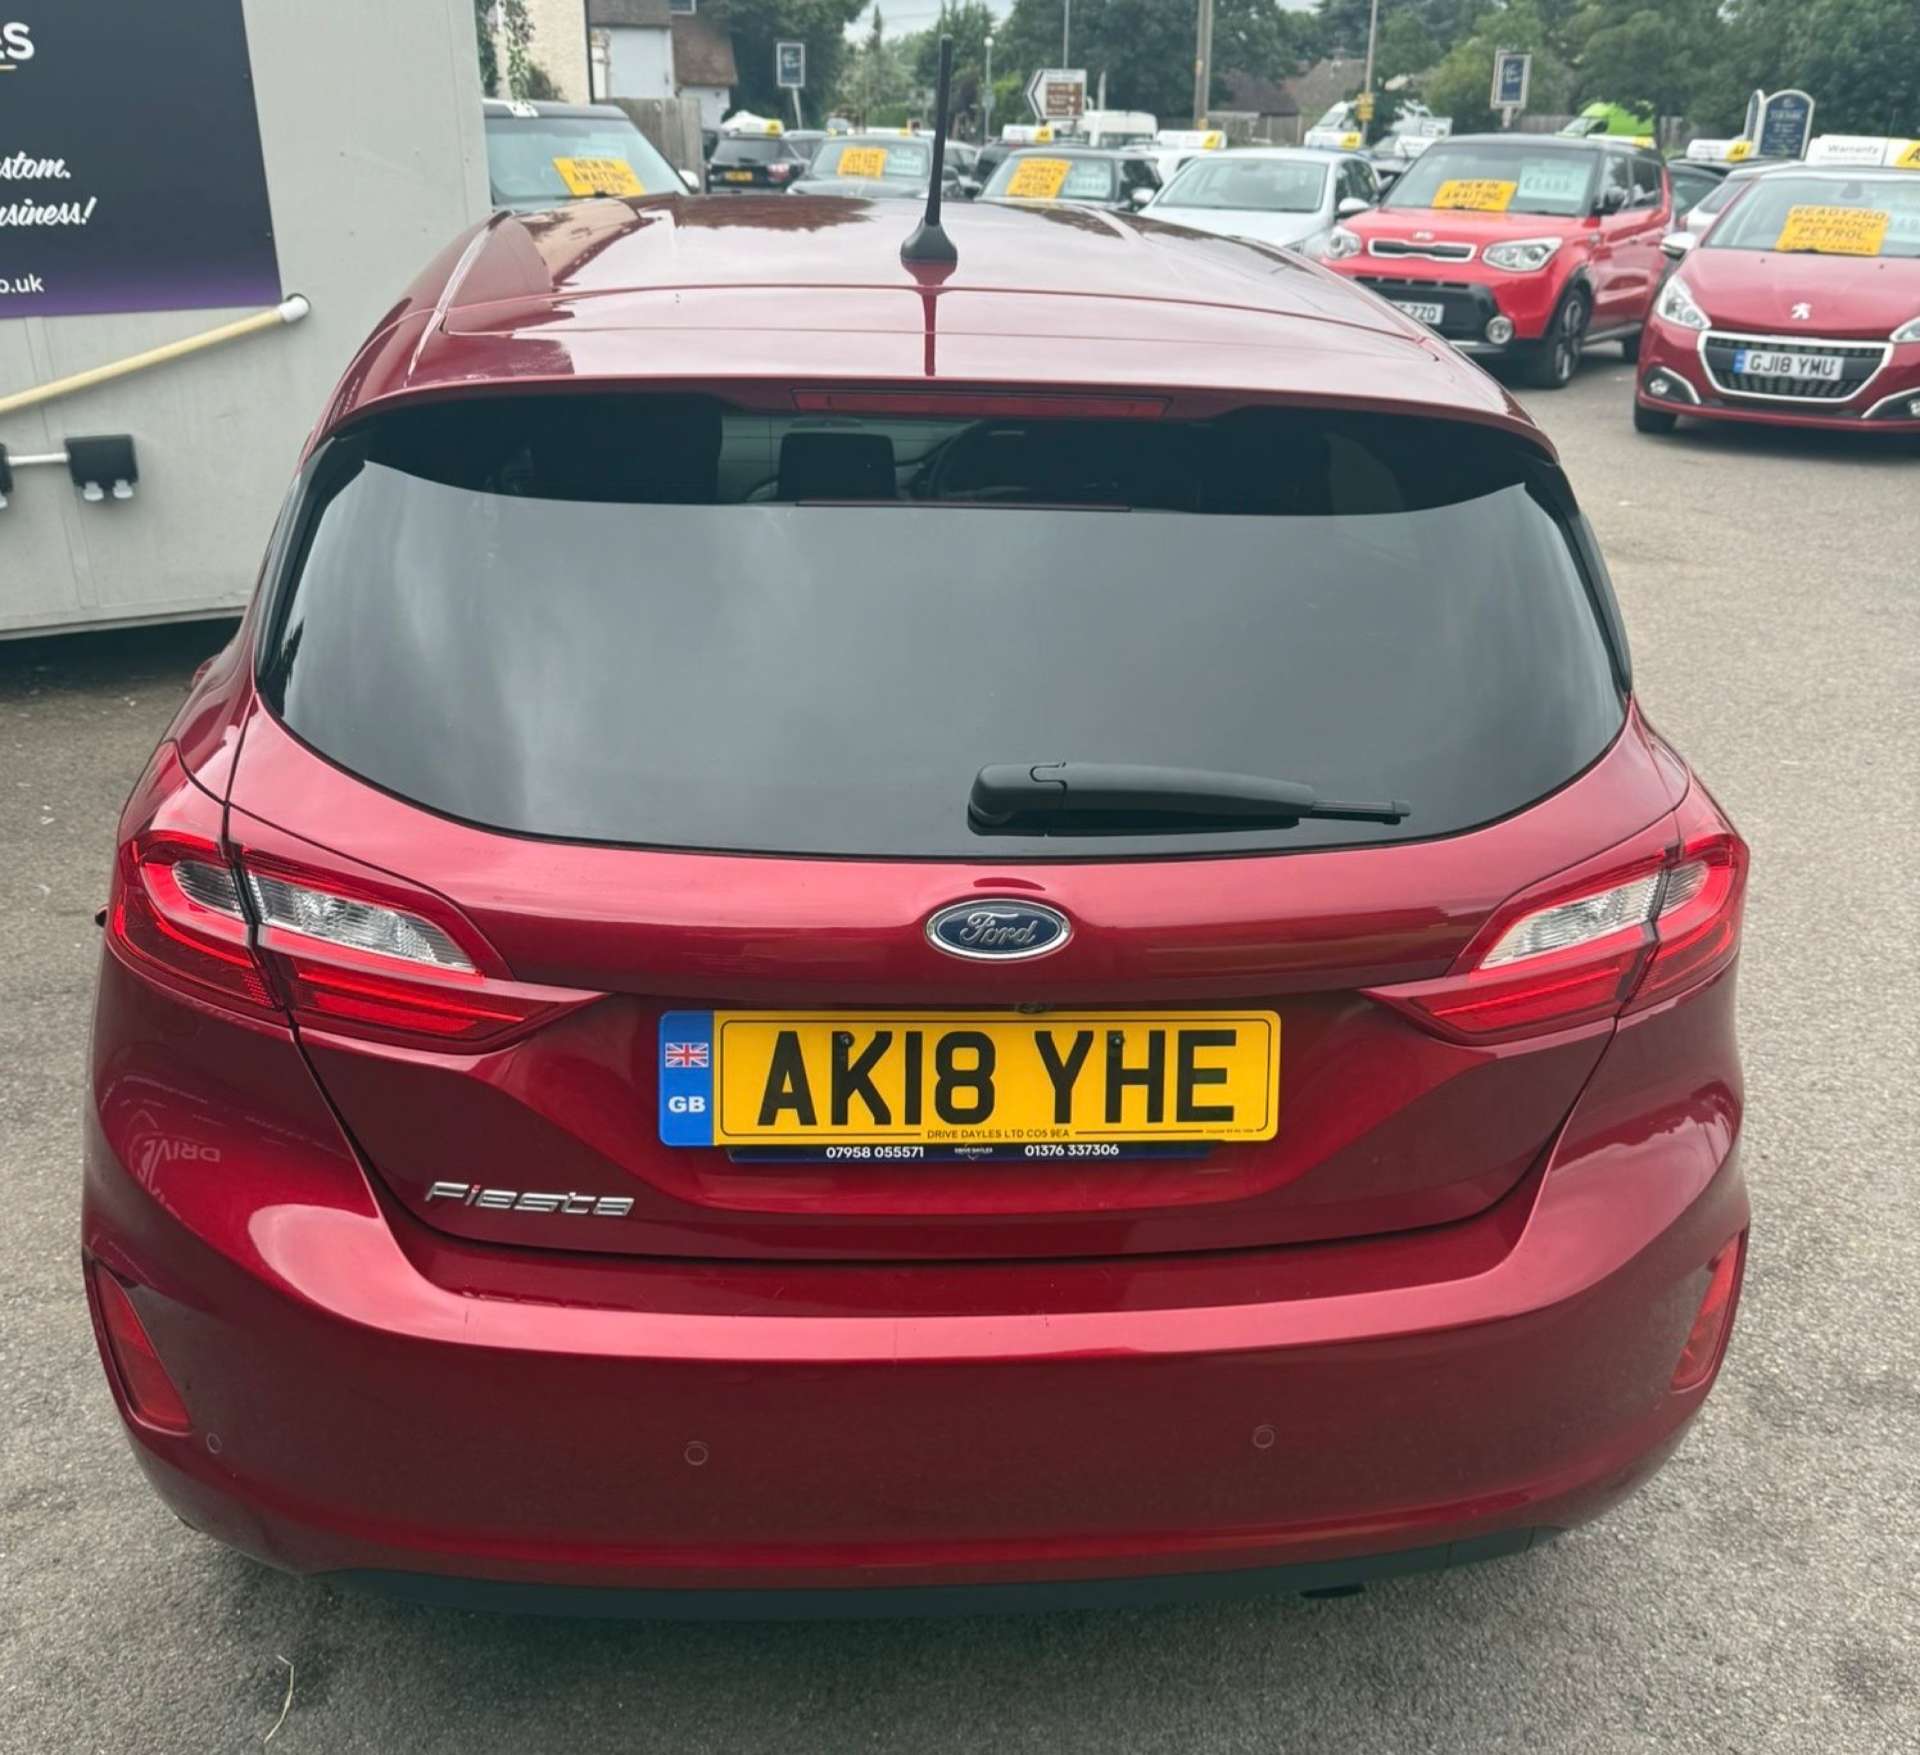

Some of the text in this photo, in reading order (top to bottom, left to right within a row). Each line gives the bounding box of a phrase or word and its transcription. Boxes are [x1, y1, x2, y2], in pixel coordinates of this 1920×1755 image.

[0, 150, 72, 180] stom.
[1798, 226, 1866, 240] PETROL
[1750, 354, 1836, 376] GJ18 YMU
[960, 911, 1038, 945] Ford
[757, 1029, 1237, 1126] AK18 YHE
[668, 1095, 706, 1114] GB
[927, 1129, 959, 1139] DRIVE
[961, 1128, 1001, 1139] DAYLES
[1004, 1128, 1024, 1138] LTD
[1050, 1127, 1070, 1138] 9EA
[826, 1145, 925, 1158] 07958 055571
[1024, 1144, 1120, 1157] 01376 337306
[425, 1181, 635, 1216] Fiesta
